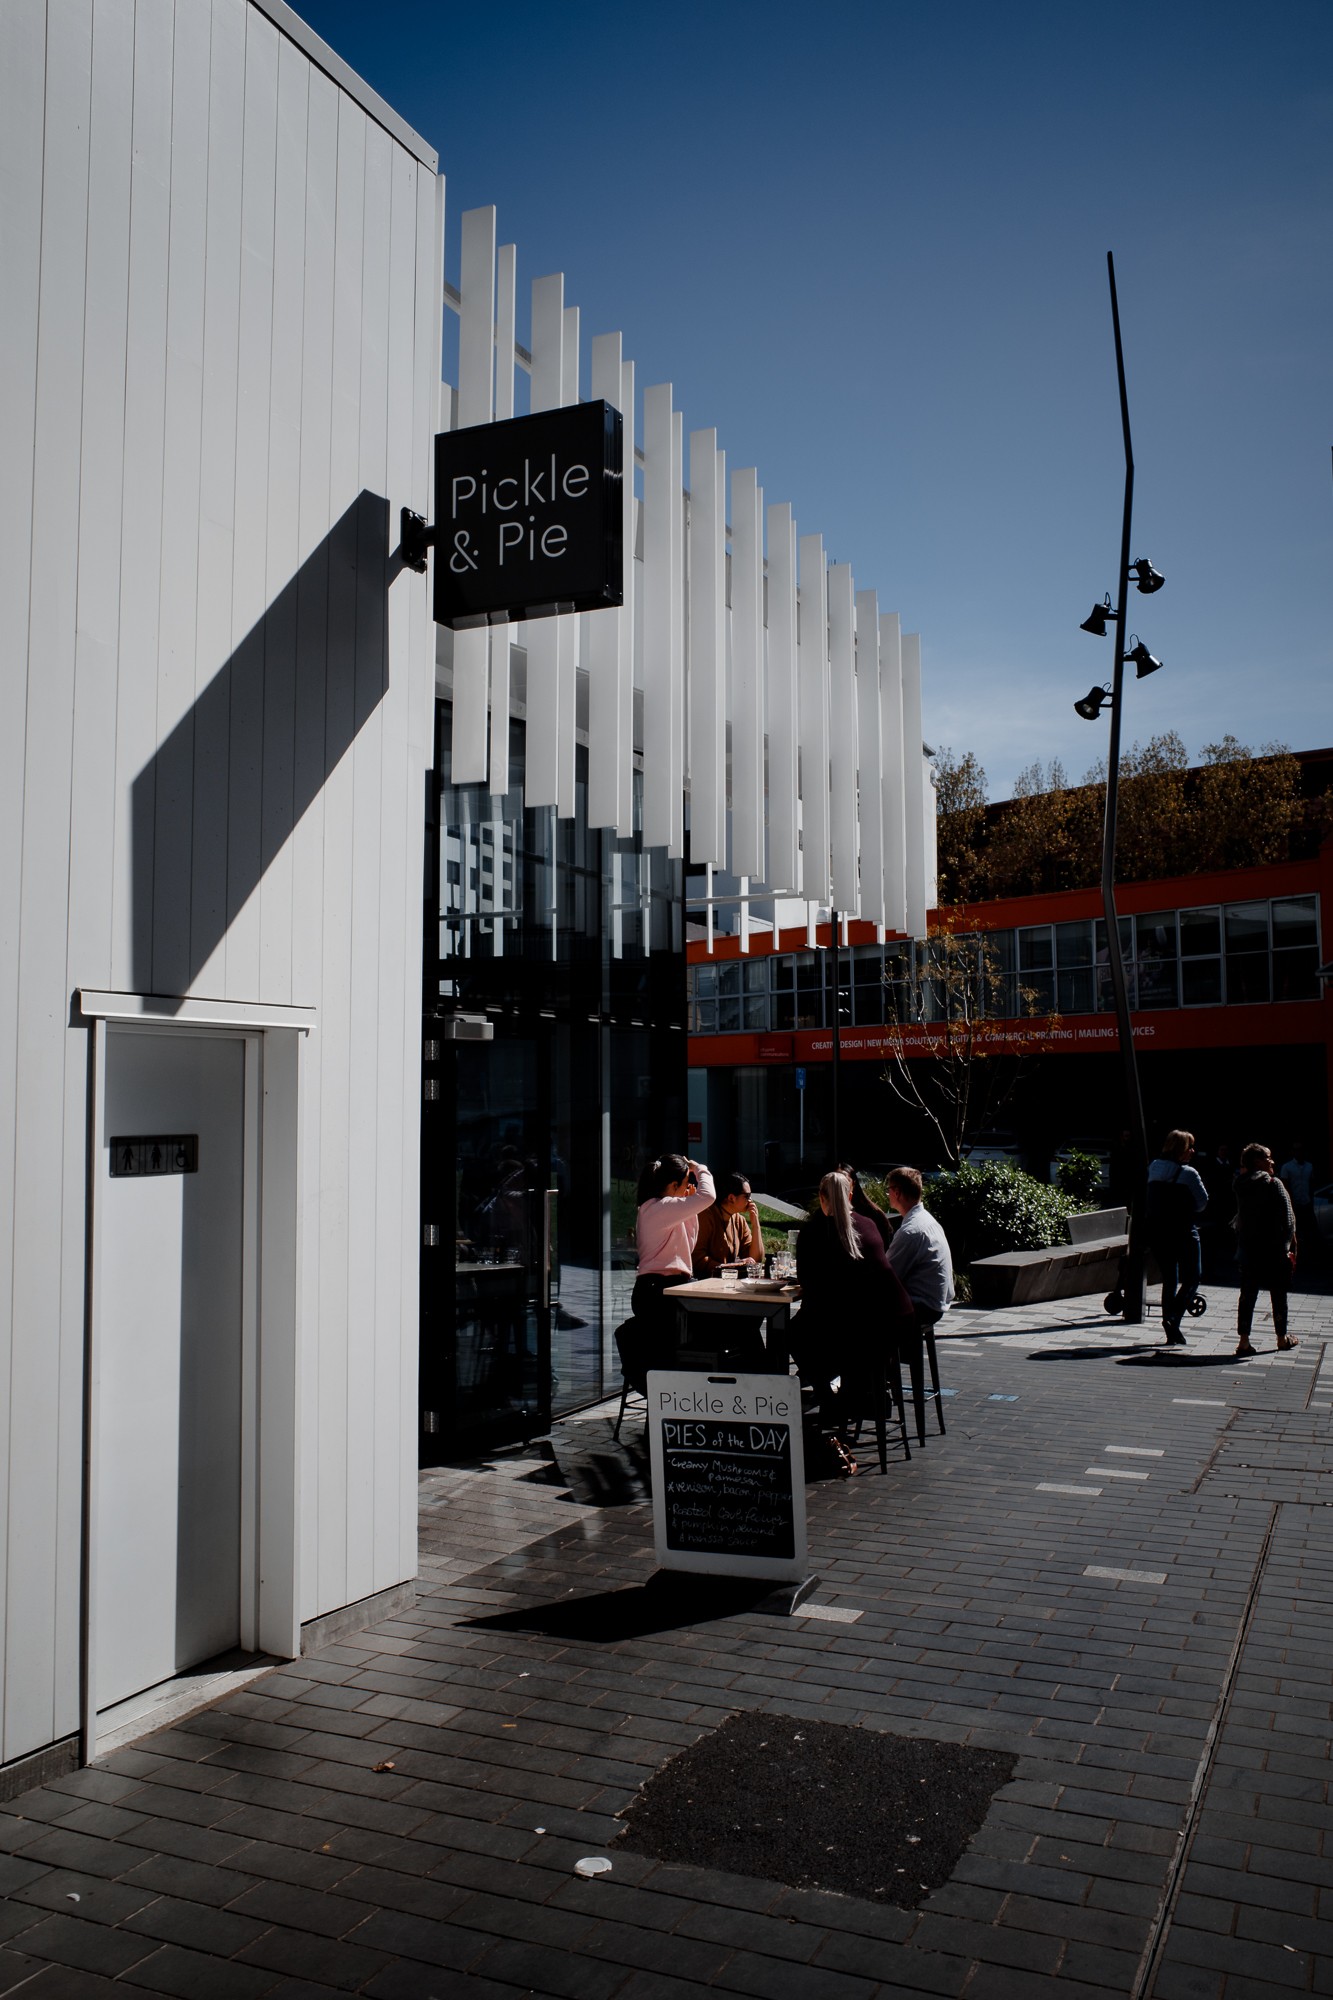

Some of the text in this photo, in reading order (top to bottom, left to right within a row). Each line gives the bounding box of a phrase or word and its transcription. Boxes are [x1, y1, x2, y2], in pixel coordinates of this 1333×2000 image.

[451, 453, 590, 519] Pickle
[449, 515, 568, 574] & Pie
[840, 1039, 863, 1049] DESIGN
[867, 1039, 882, 1047] NEW
[1078, 1028, 1114, 1038] MAILING
[660, 1391, 788, 1416] Pickle & Pie
[664, 1423, 788, 1452] PIES of the DAY
